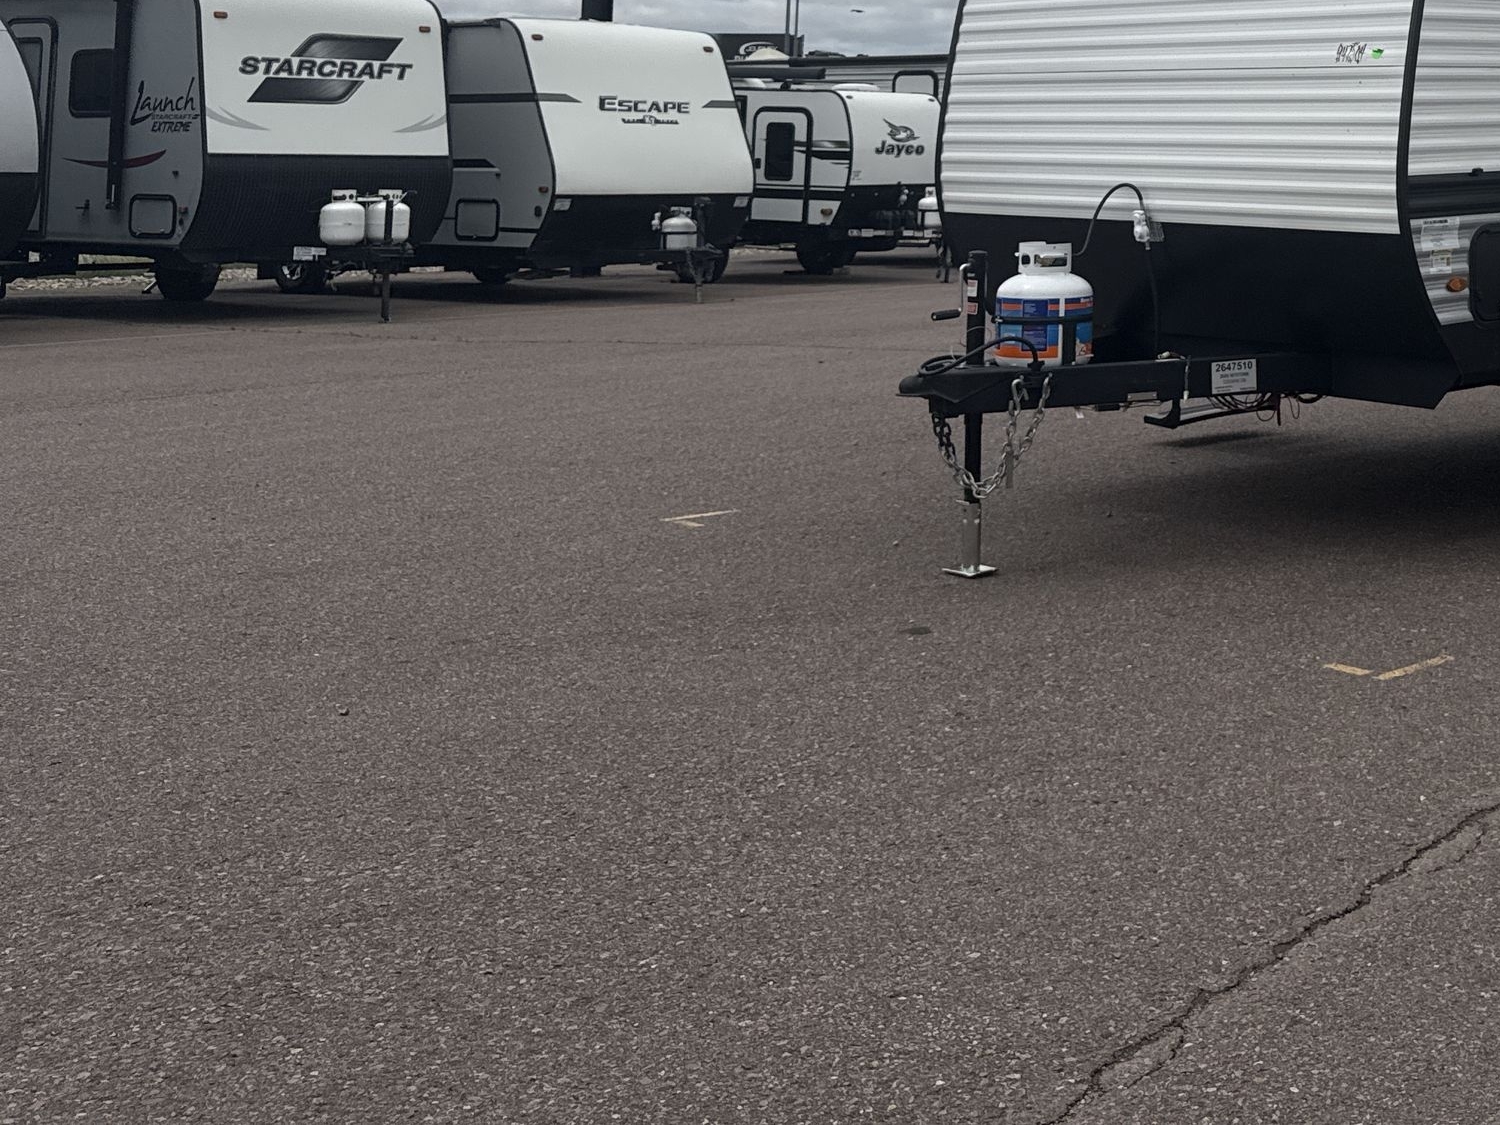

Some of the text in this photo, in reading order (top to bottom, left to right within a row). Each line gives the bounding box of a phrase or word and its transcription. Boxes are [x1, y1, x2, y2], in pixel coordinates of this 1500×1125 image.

[239, 56, 413, 81] STARCRAFT
[130, 76, 196, 126] Launch
[151, 121, 192, 132] EXTREME
[875, 140, 925, 159] Jayco
[1215, 361, 1253, 373] 2647510
